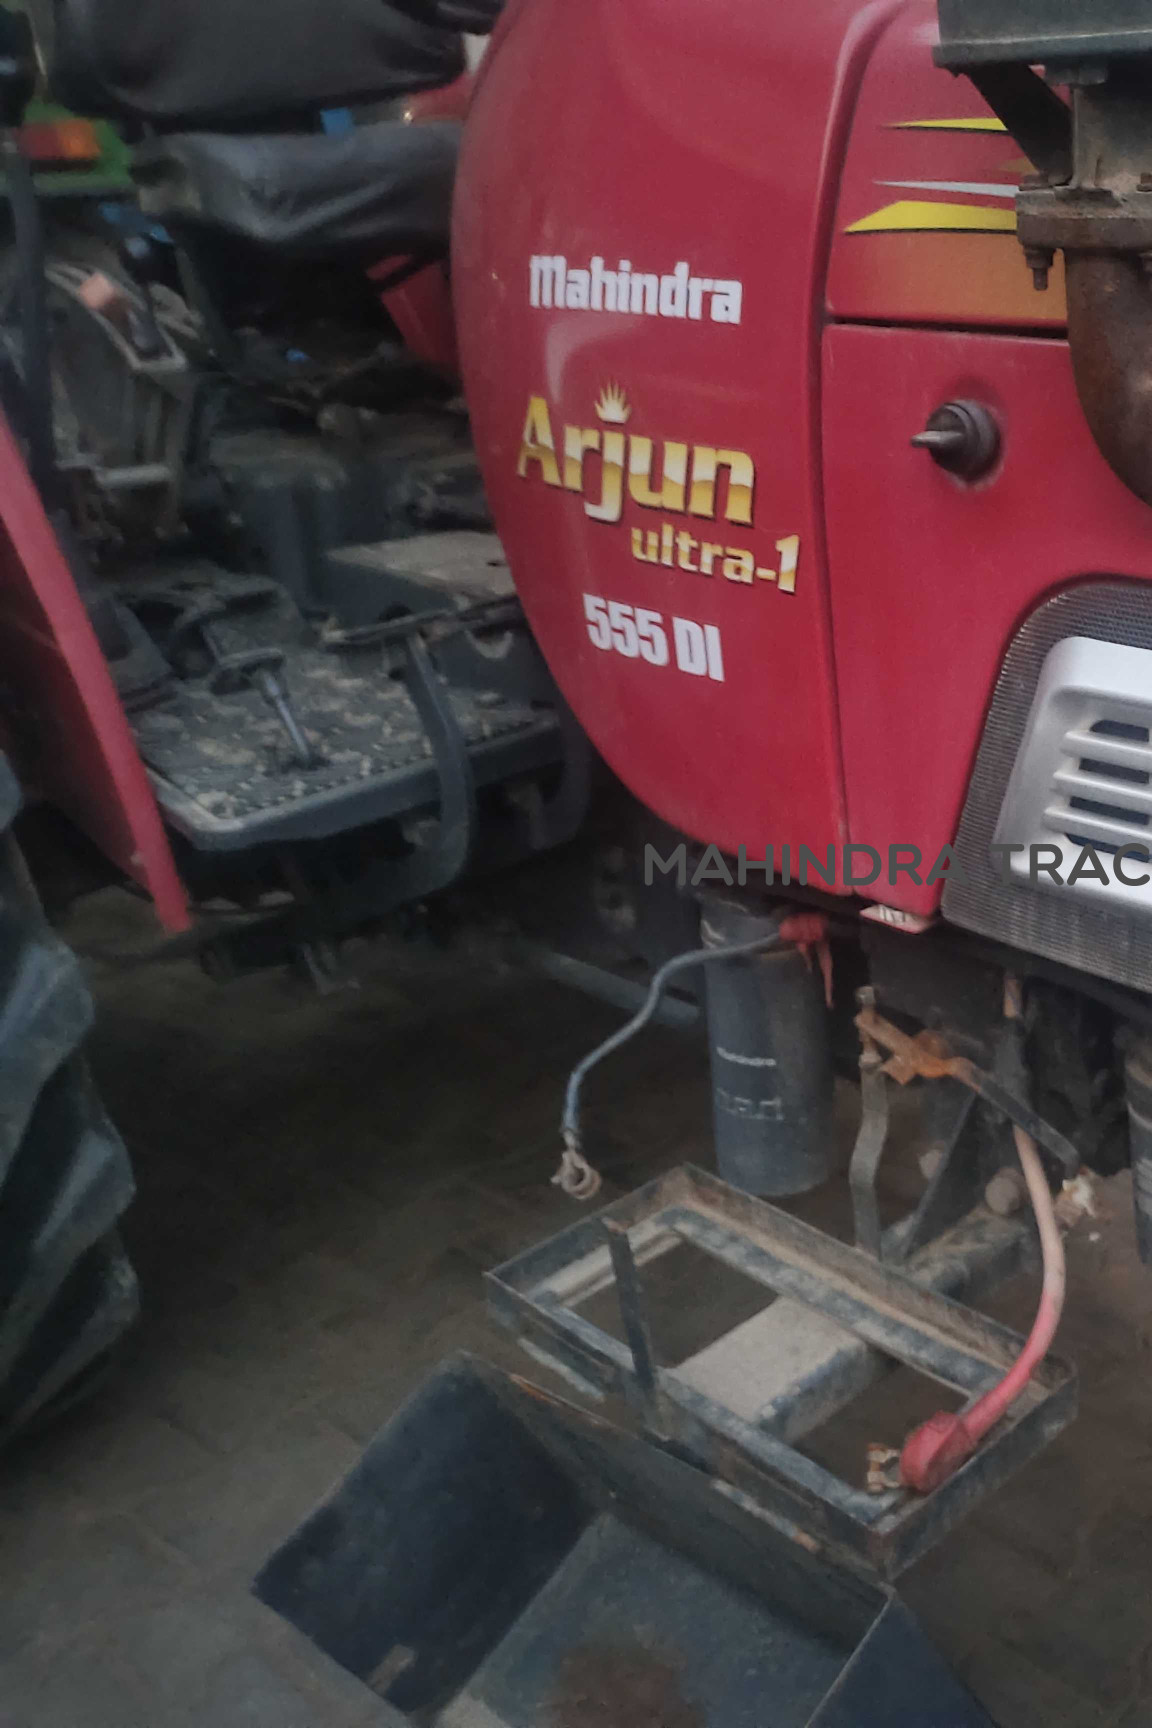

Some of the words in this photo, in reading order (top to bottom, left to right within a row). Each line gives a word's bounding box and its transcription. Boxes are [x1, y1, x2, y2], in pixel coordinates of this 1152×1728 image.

[529, 254, 743, 325] Mahindra
[516, 377, 755, 525] Arjun
[630, 522, 801, 594] ultra-1
[582, 592, 668, 667] 555
[673, 615, 726, 682] DI
